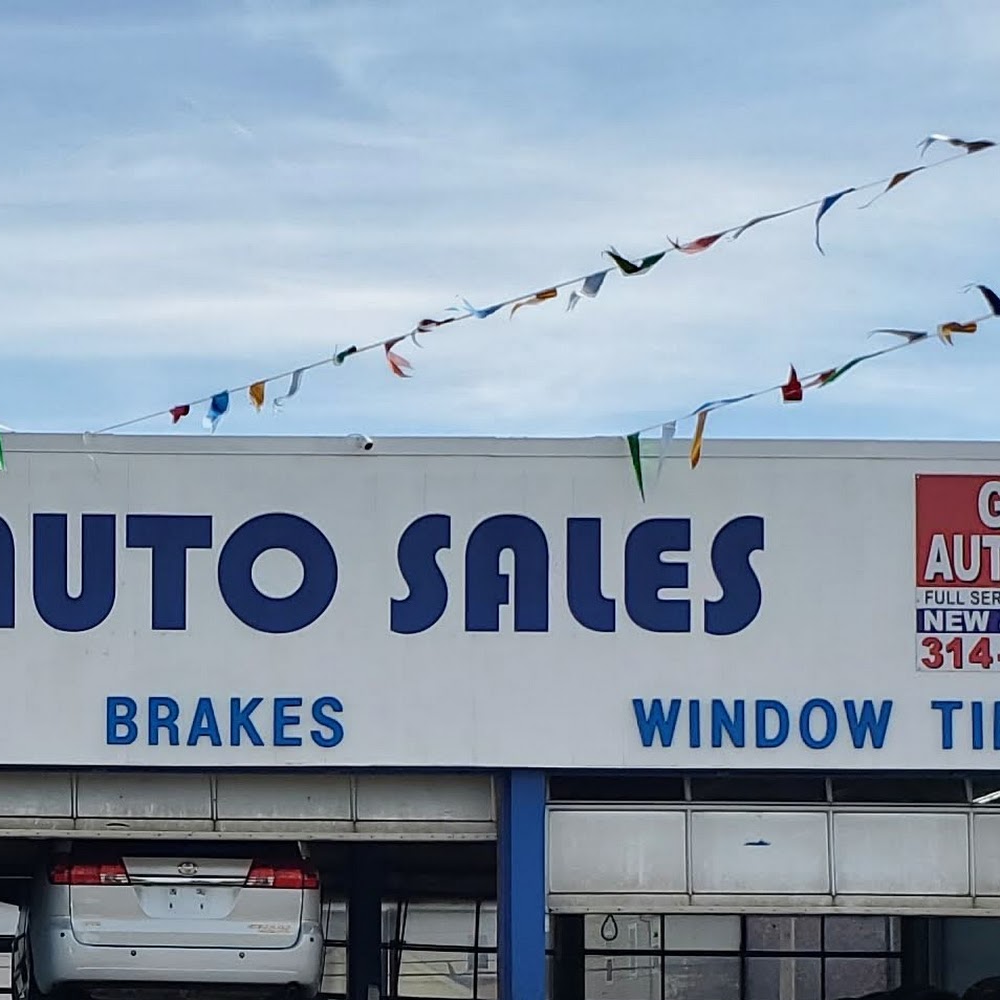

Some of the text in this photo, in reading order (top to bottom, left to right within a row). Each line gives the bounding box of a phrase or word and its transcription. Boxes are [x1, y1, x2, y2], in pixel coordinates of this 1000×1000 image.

[390, 512, 765, 636] SALES
[924, 590, 965, 605] FULL
[924, 609, 990, 632] NEW
[106, 695, 345, 748] BRAKES
[632, 697, 1000, 750] WINDOW TI
